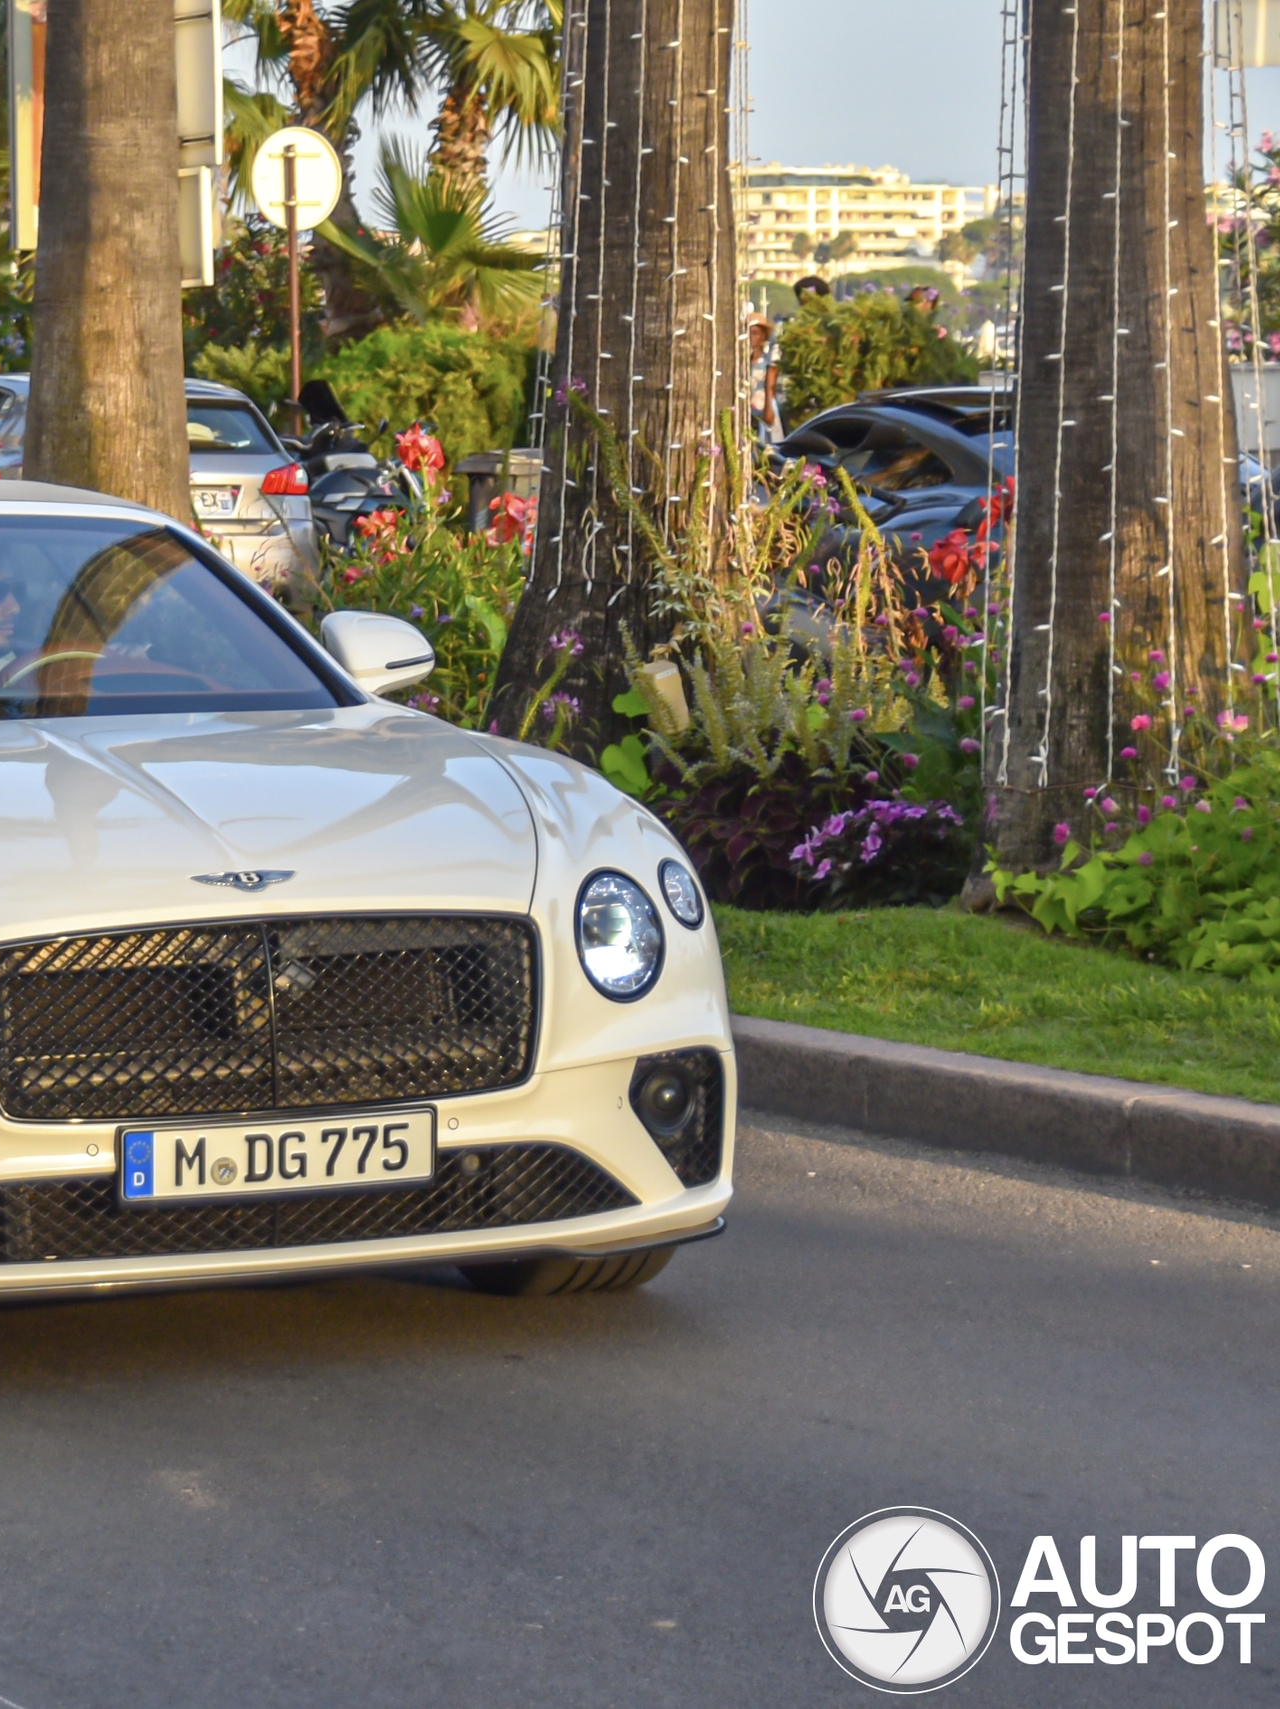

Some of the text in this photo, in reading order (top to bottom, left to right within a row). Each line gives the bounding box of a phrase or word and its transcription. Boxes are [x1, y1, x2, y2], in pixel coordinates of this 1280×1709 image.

[175, 1122, 409, 1187] M DG 775
[133, 1172, 145, 1187] D
